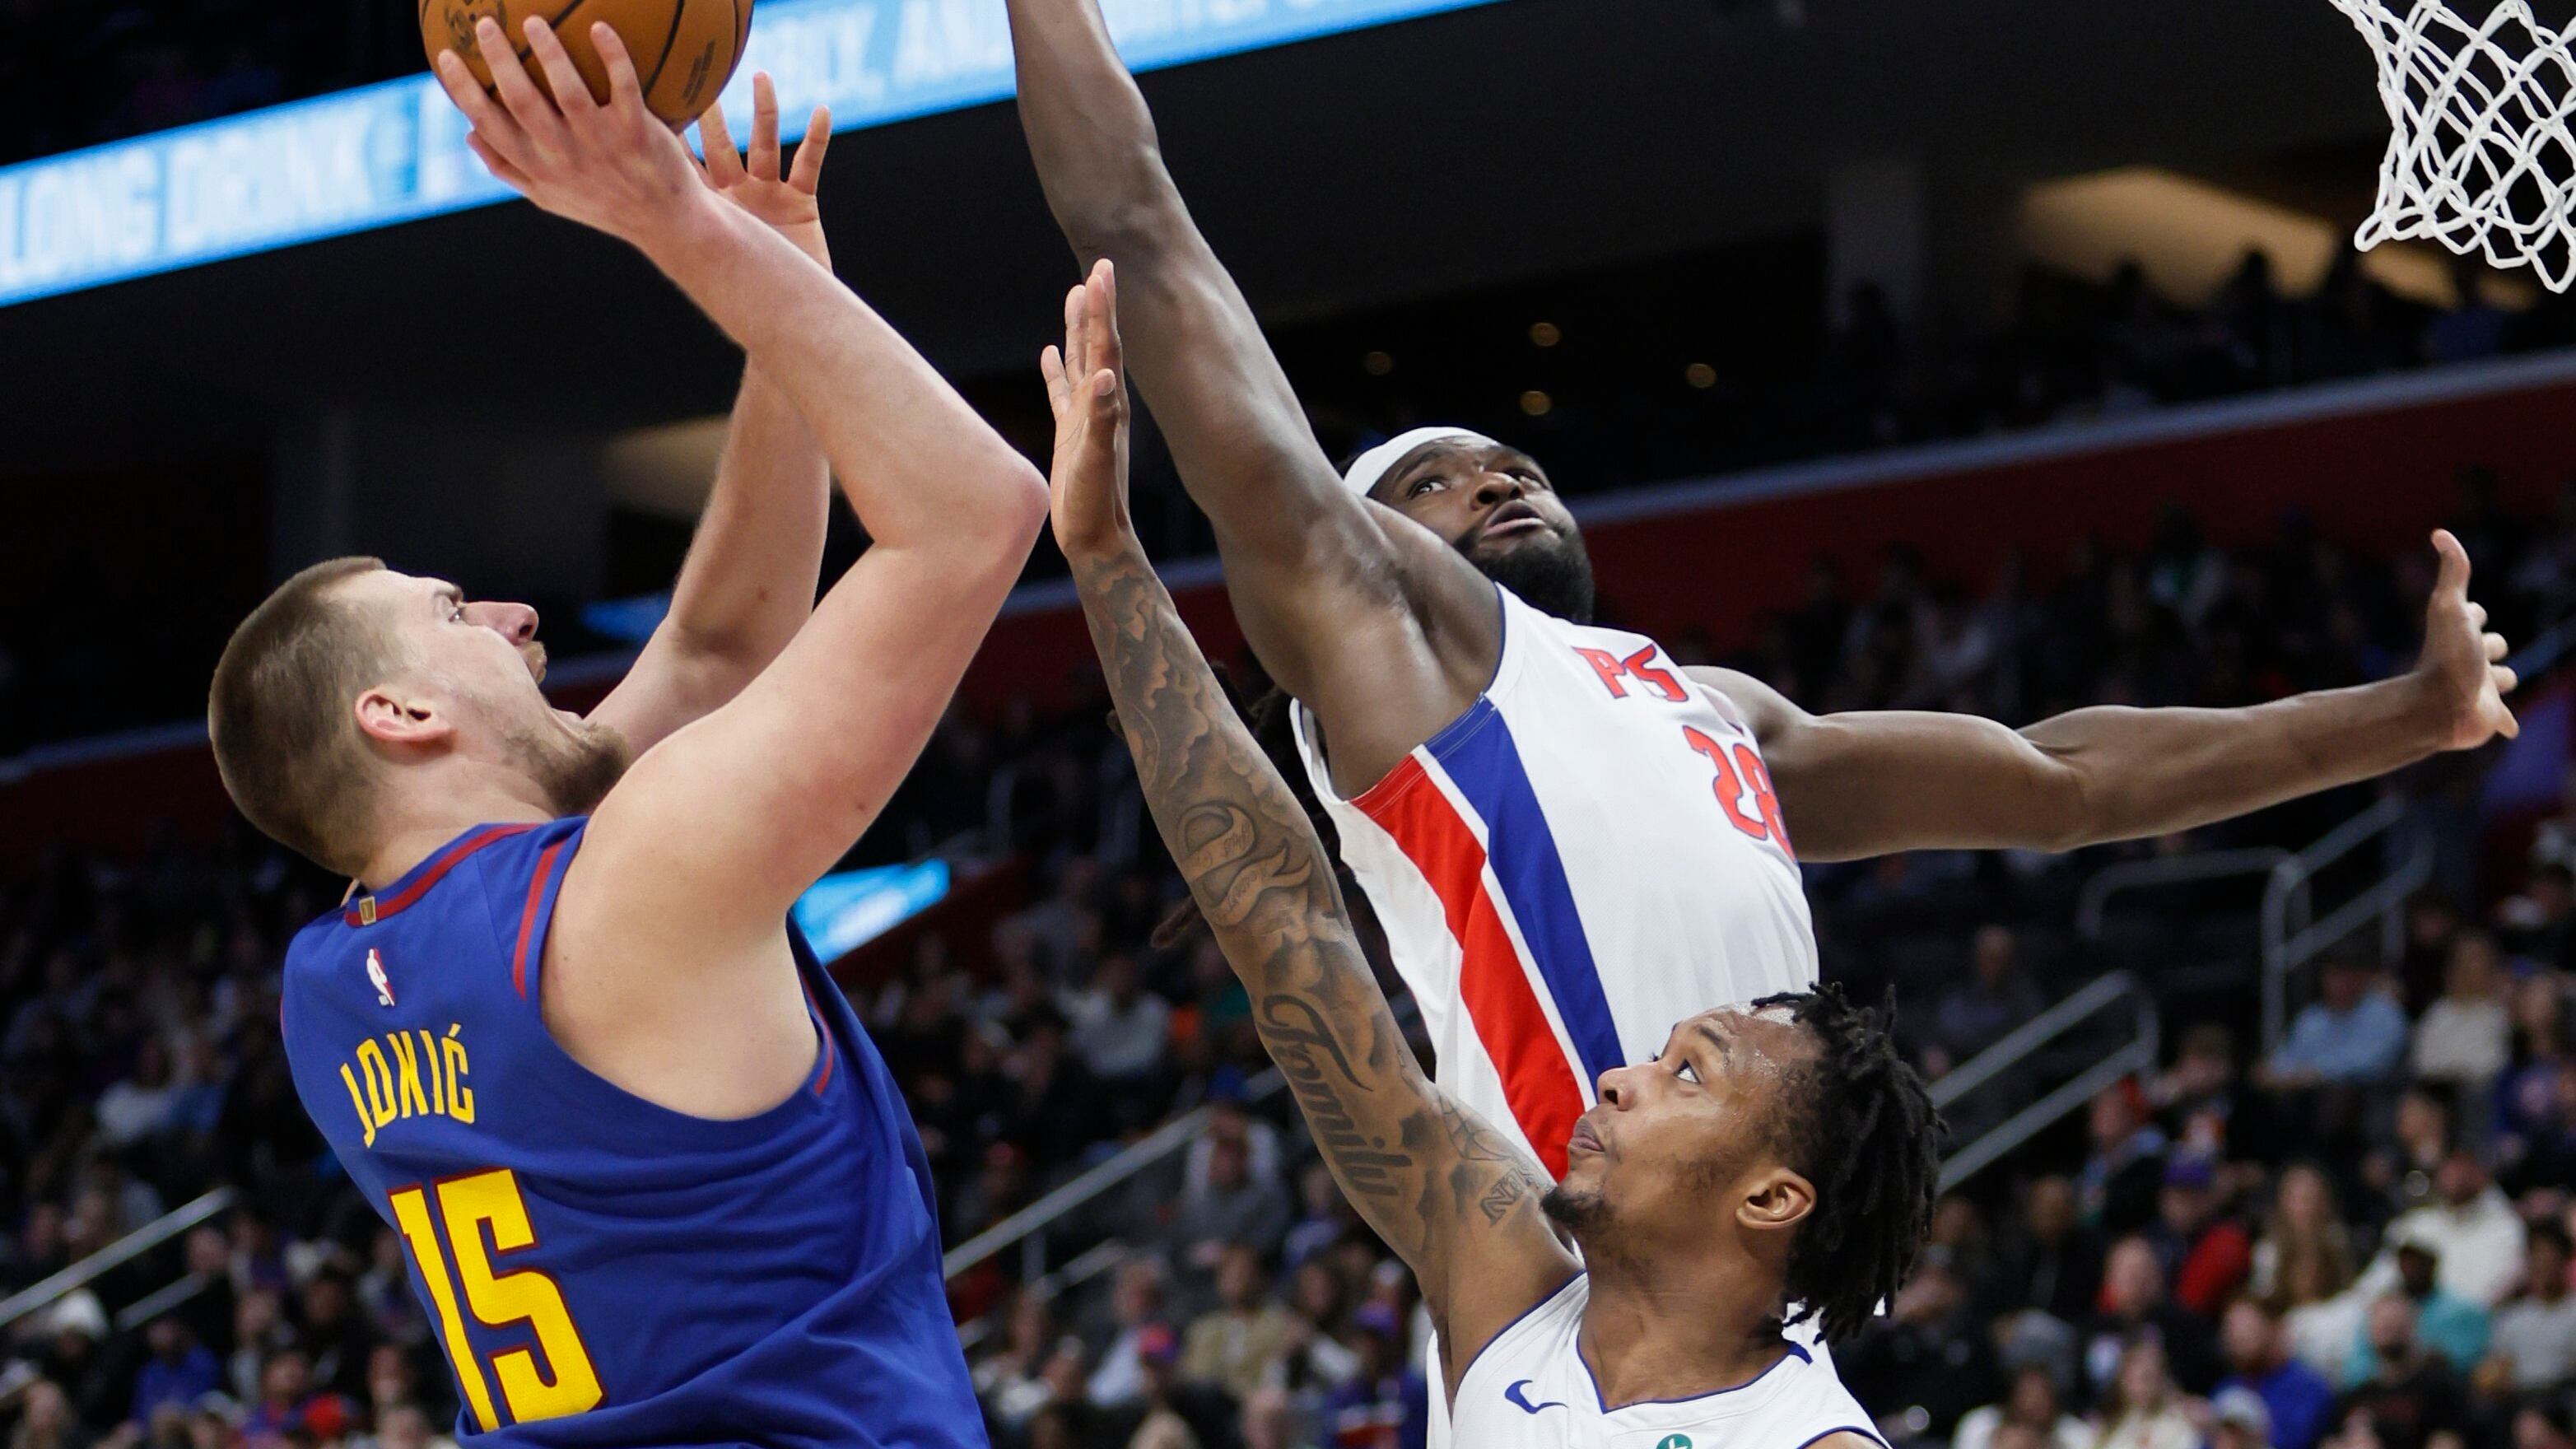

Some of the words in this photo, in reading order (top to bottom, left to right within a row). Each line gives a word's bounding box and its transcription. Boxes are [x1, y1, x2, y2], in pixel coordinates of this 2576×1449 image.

[168, 107, 374, 250] DRINK
[1682, 724, 1798, 864] 28
[340, 1023, 475, 1148] JOKIĆ
[388, 1167, 604, 1434] 15
